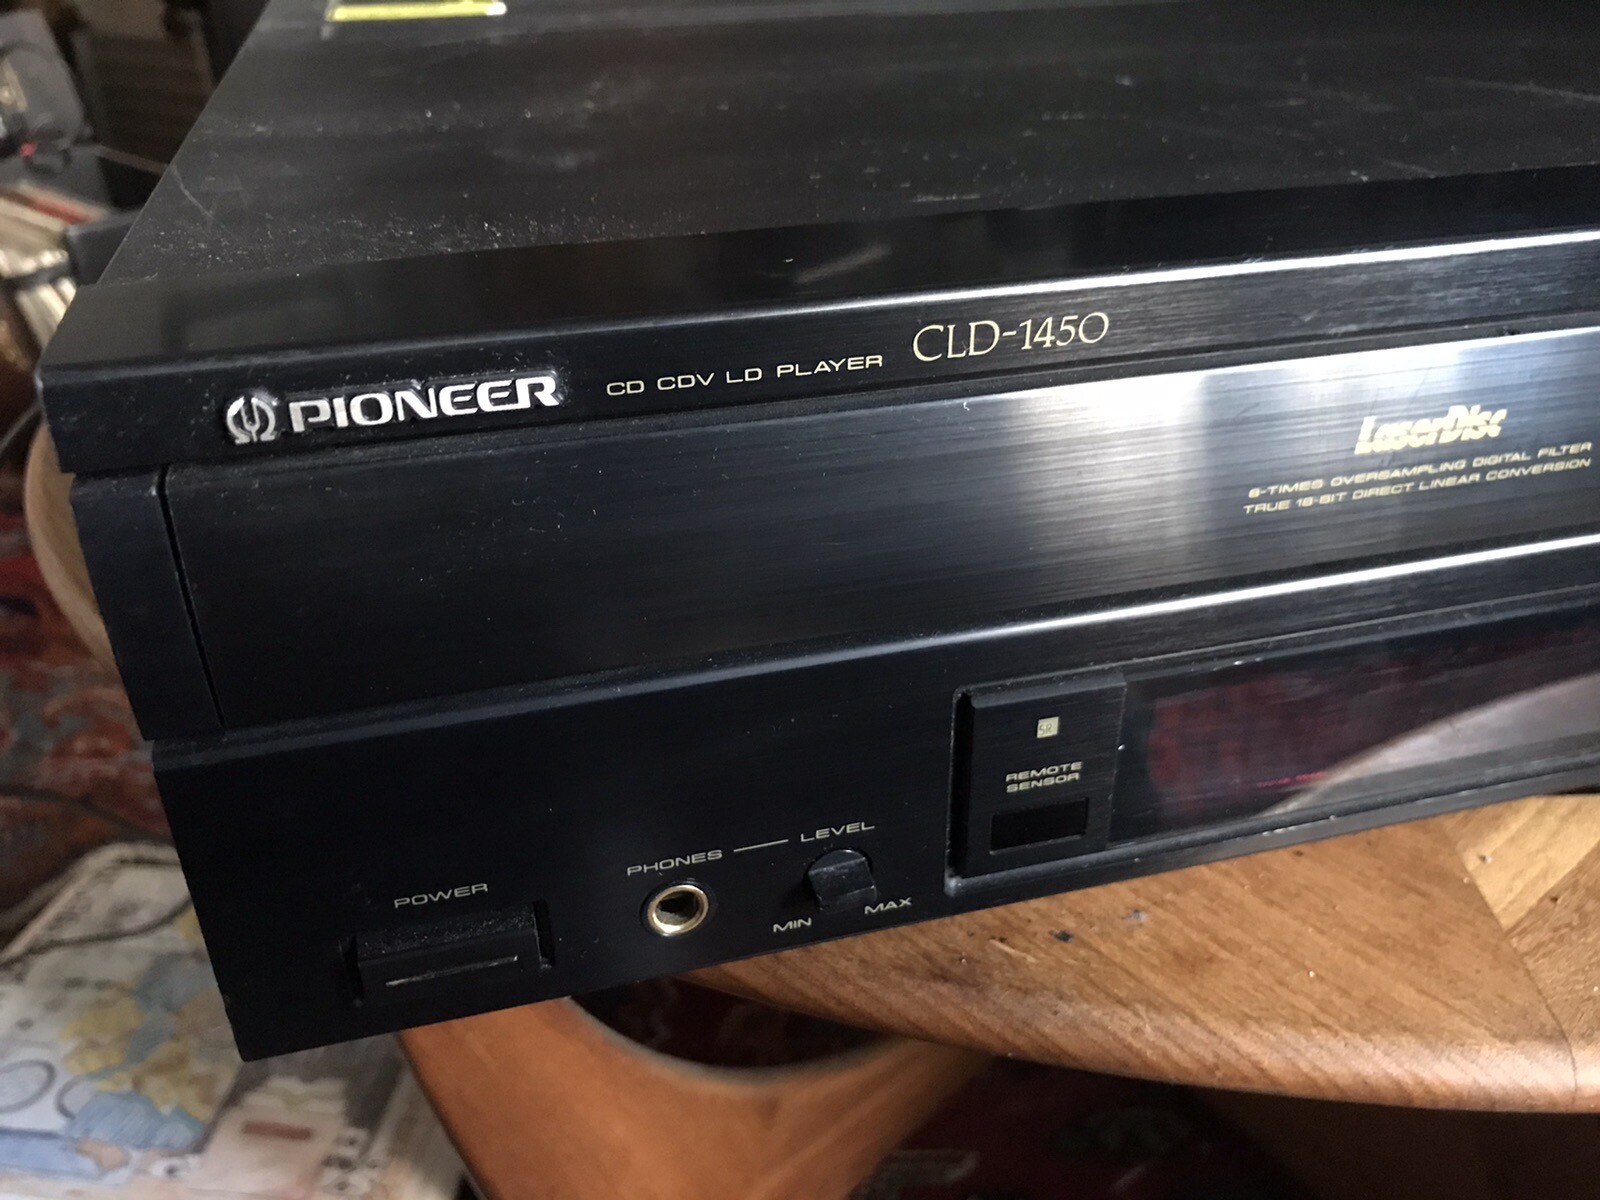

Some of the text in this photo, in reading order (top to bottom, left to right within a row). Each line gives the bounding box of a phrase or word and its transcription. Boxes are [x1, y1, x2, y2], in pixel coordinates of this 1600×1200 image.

[911, 311, 1110, 363] CLD-1450
[606, 354, 883, 396] CD CDV LD PLAYER
[289, 375, 562, 435] PIONEER
[1353, 404, 1508, 456] LaserDisc
[1330, 459, 1467, 487] OVERSAMPLING
[1472, 451, 1532, 468] DIGITAL
[1537, 441, 1593, 459] FILTER
[1242, 499, 1291, 515] TRUE
[1352, 482, 1415, 501] DIRECT
[1418, 472, 1481, 491] LINEAR
[1485, 457, 1592, 482] CONVERSION
[1005, 761, 1084, 782] REMOTE
[1006, 772, 1081, 793] SENSOR
[800, 821, 876, 843] LEVEL
[626, 849, 723, 877] PHONES
[393, 883, 489, 909] POWER
[863, 896, 913, 915] MAX
[772, 917, 813, 933] MIN
